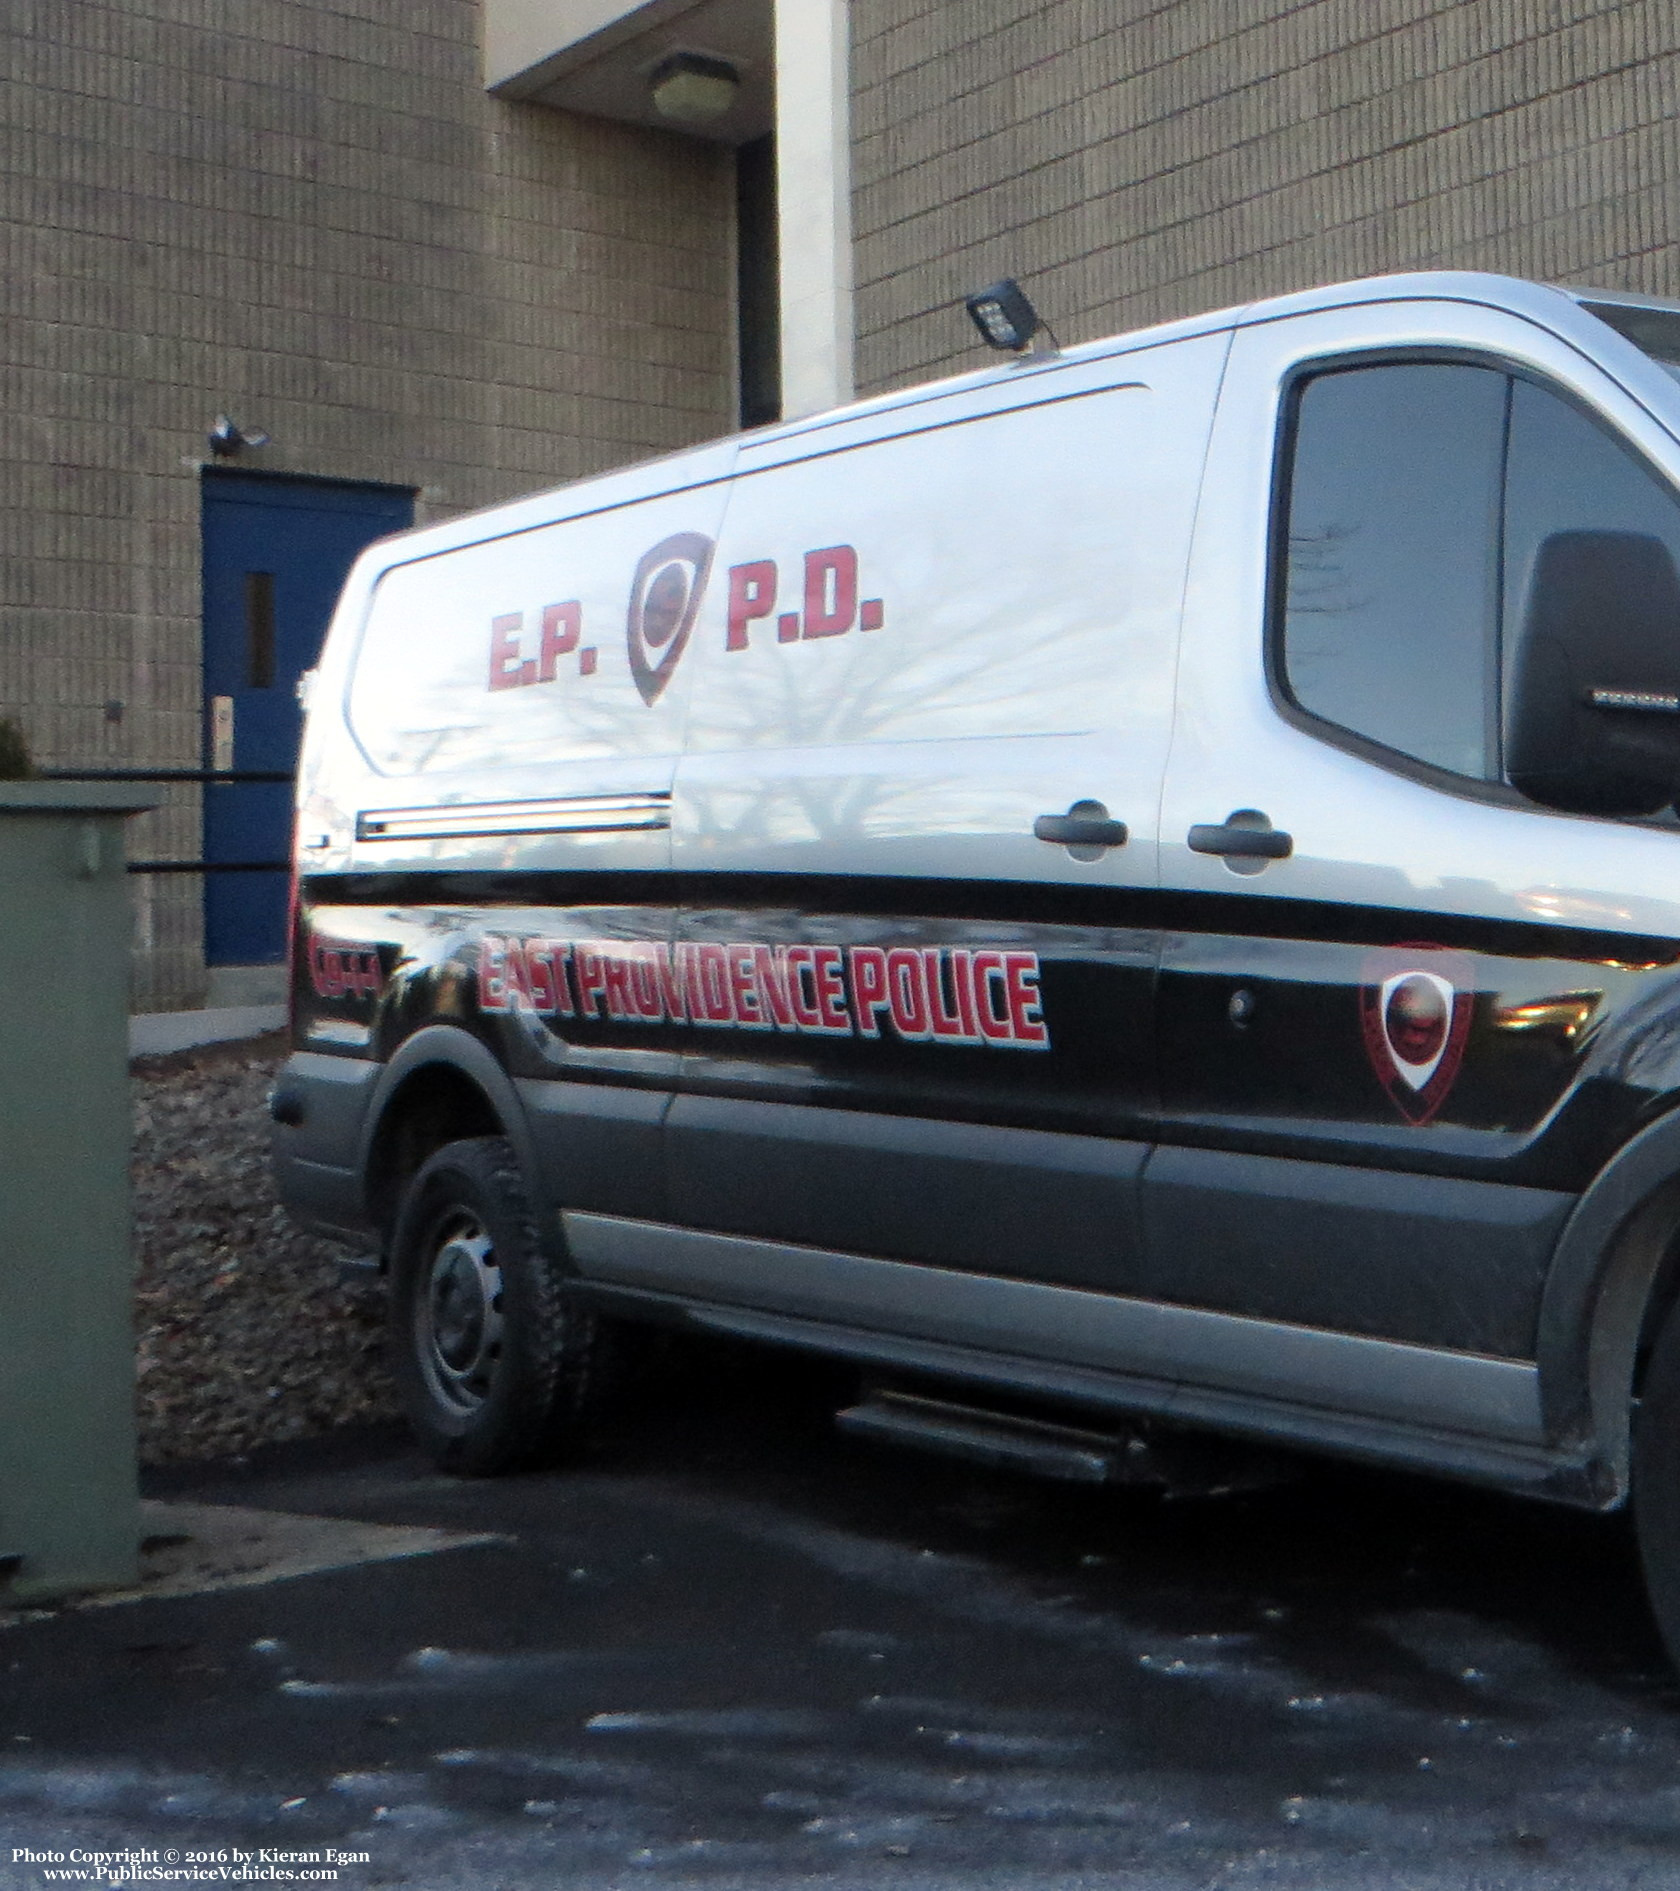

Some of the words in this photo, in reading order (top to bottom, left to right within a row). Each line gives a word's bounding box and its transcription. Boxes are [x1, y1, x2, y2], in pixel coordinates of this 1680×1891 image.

[488, 600, 598, 692] E.P.
[726, 544, 884, 652] P.D.
[479, 936, 576, 1017] EAST
[572, 939, 852, 1043] PROVIDENCE
[849, 945, 1050, 1051] POLICE
